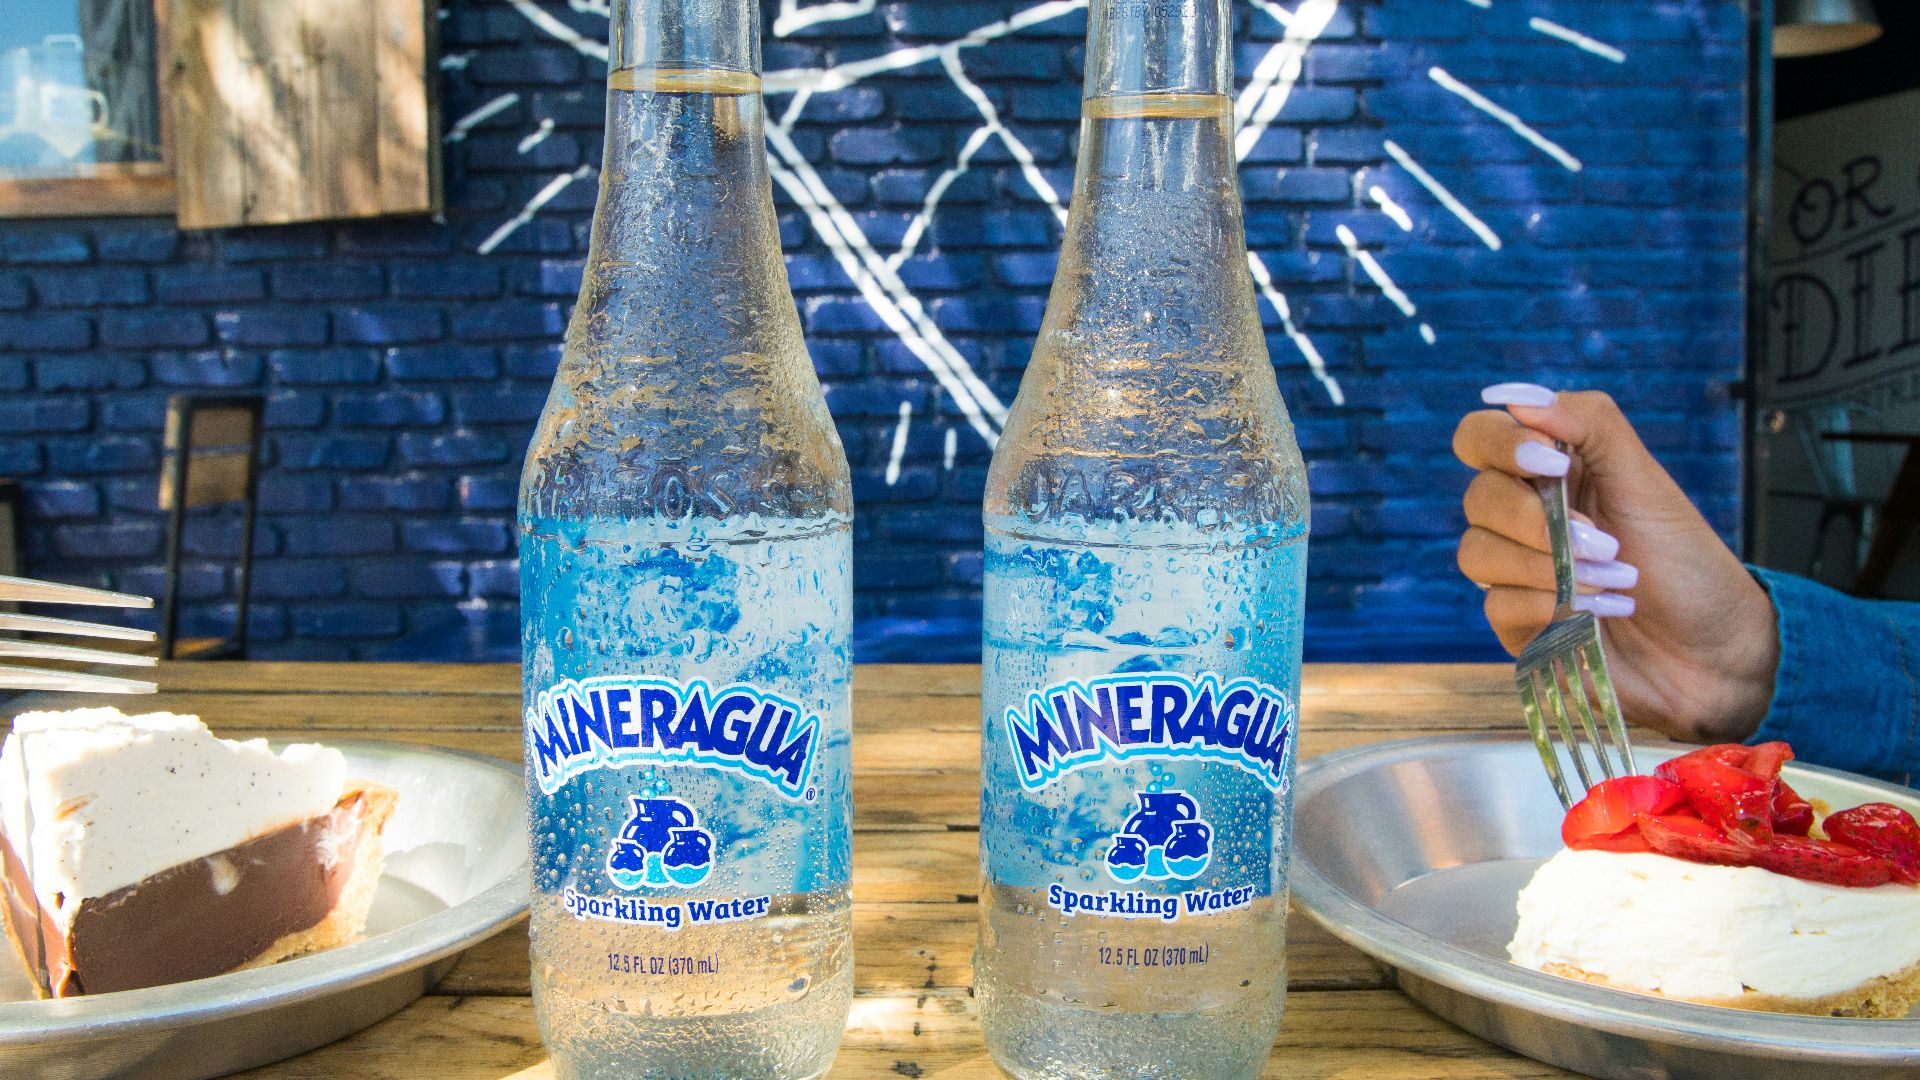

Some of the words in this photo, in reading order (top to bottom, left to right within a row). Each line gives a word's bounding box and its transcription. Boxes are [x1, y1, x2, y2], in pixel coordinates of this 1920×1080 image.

[1790, 155, 1893, 245] OR
[530, 688, 812, 785] MINERAGUA
[1010, 684, 1290, 777] MINERAGUA
[565, 888, 681, 928] Sparkling
[688, 895, 769, 922] Water
[1050, 884, 1178, 919] Sparkling
[1185, 885, 1253, 912] Water
[608, 953, 630, 973] 12.5
[634, 955, 646, 974] FL
[650, 957, 665, 975] OZ
[668, 954, 694, 975] (370
[697, 952, 719, 974] mL)
[1099, 947, 1123, 965] 12.5
[1127, 948, 1139, 966] FL
[1144, 948, 1159, 966] OZ
[1162, 945, 1185, 967] (370
[1189, 943, 1209, 965] mL)
